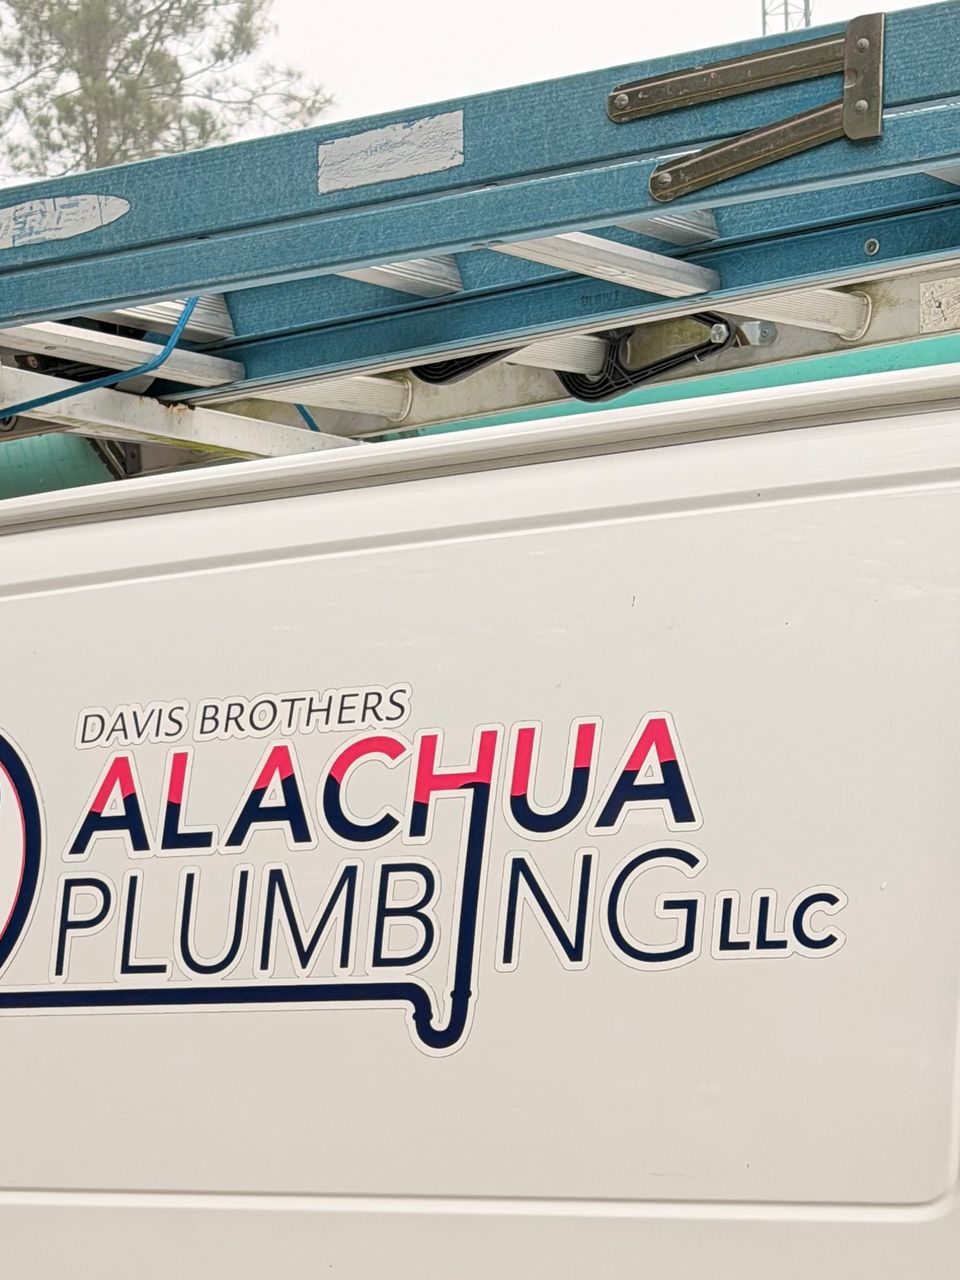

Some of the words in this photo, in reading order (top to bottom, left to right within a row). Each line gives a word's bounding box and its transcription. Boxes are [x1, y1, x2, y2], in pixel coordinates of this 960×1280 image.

[80, 705, 186, 744] DAVIS
[199, 688, 407, 736] BROTHERS
[68, 717, 697, 855] ALACHUA
[54, 846, 702, 977] PLUMBING
[718, 892, 841, 951] LLC
